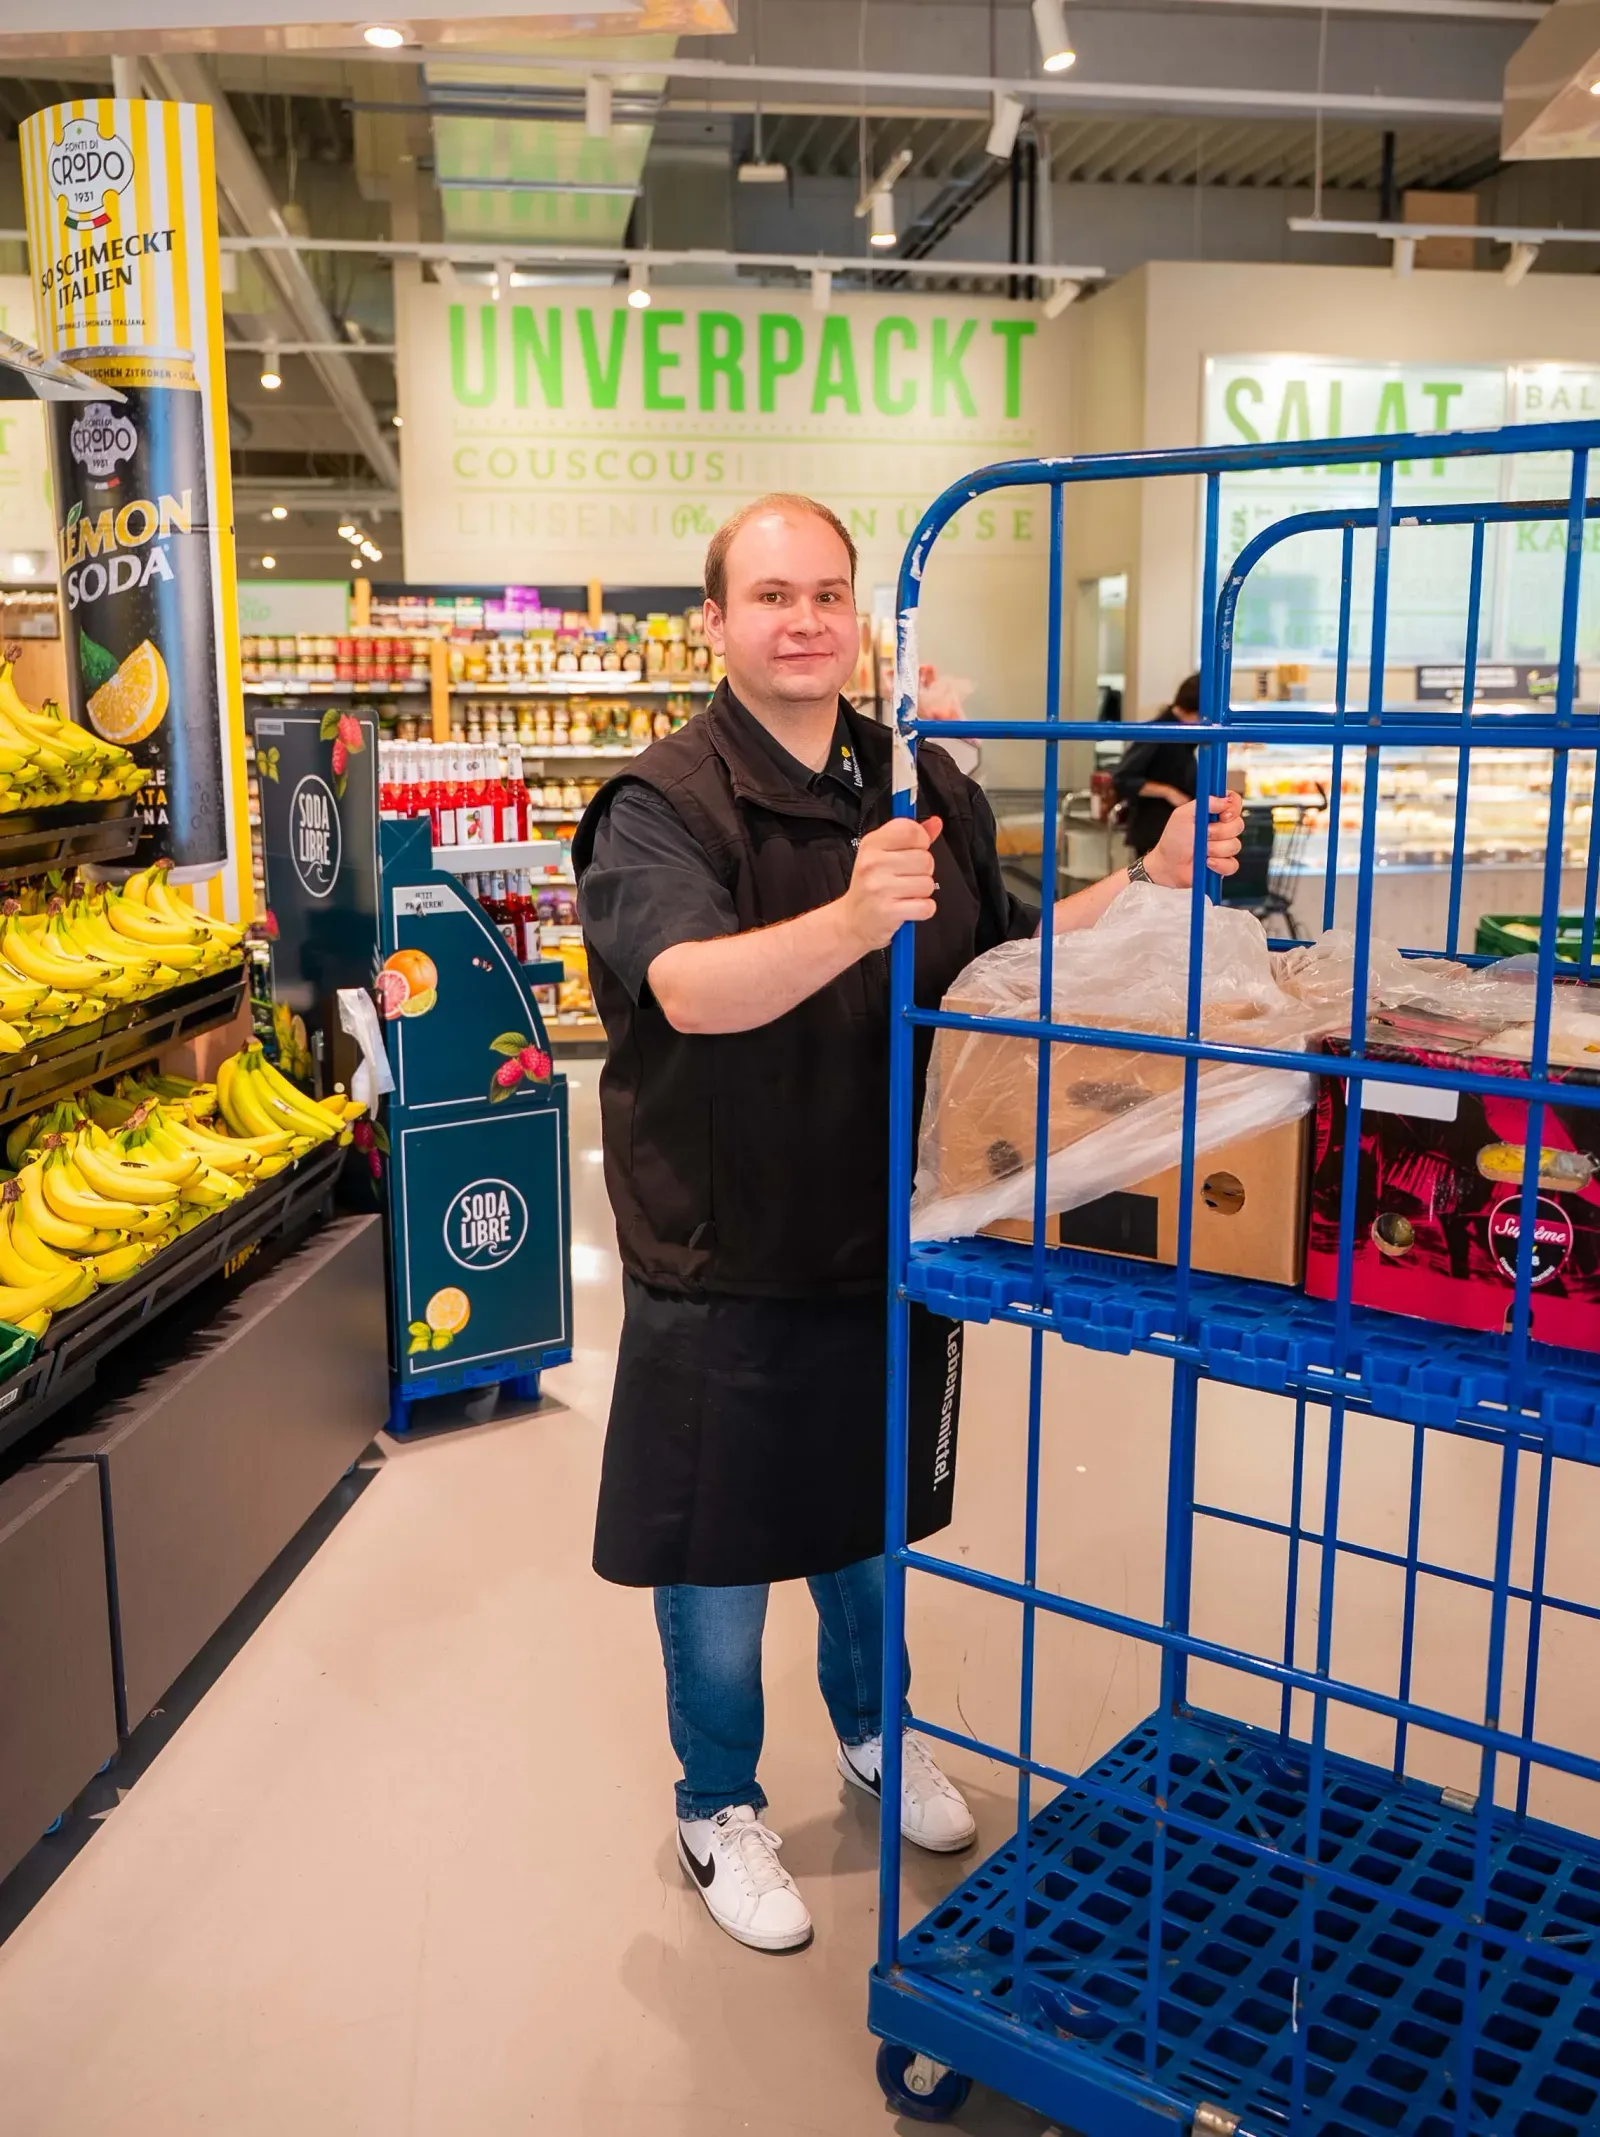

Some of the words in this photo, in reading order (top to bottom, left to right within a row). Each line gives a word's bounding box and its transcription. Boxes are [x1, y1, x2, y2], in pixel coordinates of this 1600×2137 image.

[65, 141, 87, 151] FONTI
[90, 140, 98, 149] DI
[52, 151, 124, 185] CRODO
[75, 191, 94, 202] 1931
[42, 270, 54, 296] SO
[57, 230, 175, 283] SCHMECKT
[59, 265, 133, 309] ITALIEN
[125, 368, 171, 378] ZITRONEN
[448, 304, 1037, 419] UNVERPACKT
[74, 428, 131, 452] CRODO
[1224, 377, 1463, 477] SALAT
[453, 446, 725, 482] COUSCOUS
[59, 488, 193, 576] LEMON
[457, 501, 638, 535] LINSEN
[68, 545, 175, 611] SODA
[298, 793, 329, 828] SODA
[300, 831, 331, 865] LIBRE
[461, 1190, 510, 1223] SODA
[461, 1216, 511, 1249] LIBRE
[1495, 1218, 1566, 1242] Suême
[932, 1326, 961, 1492] Lebensmittel.
